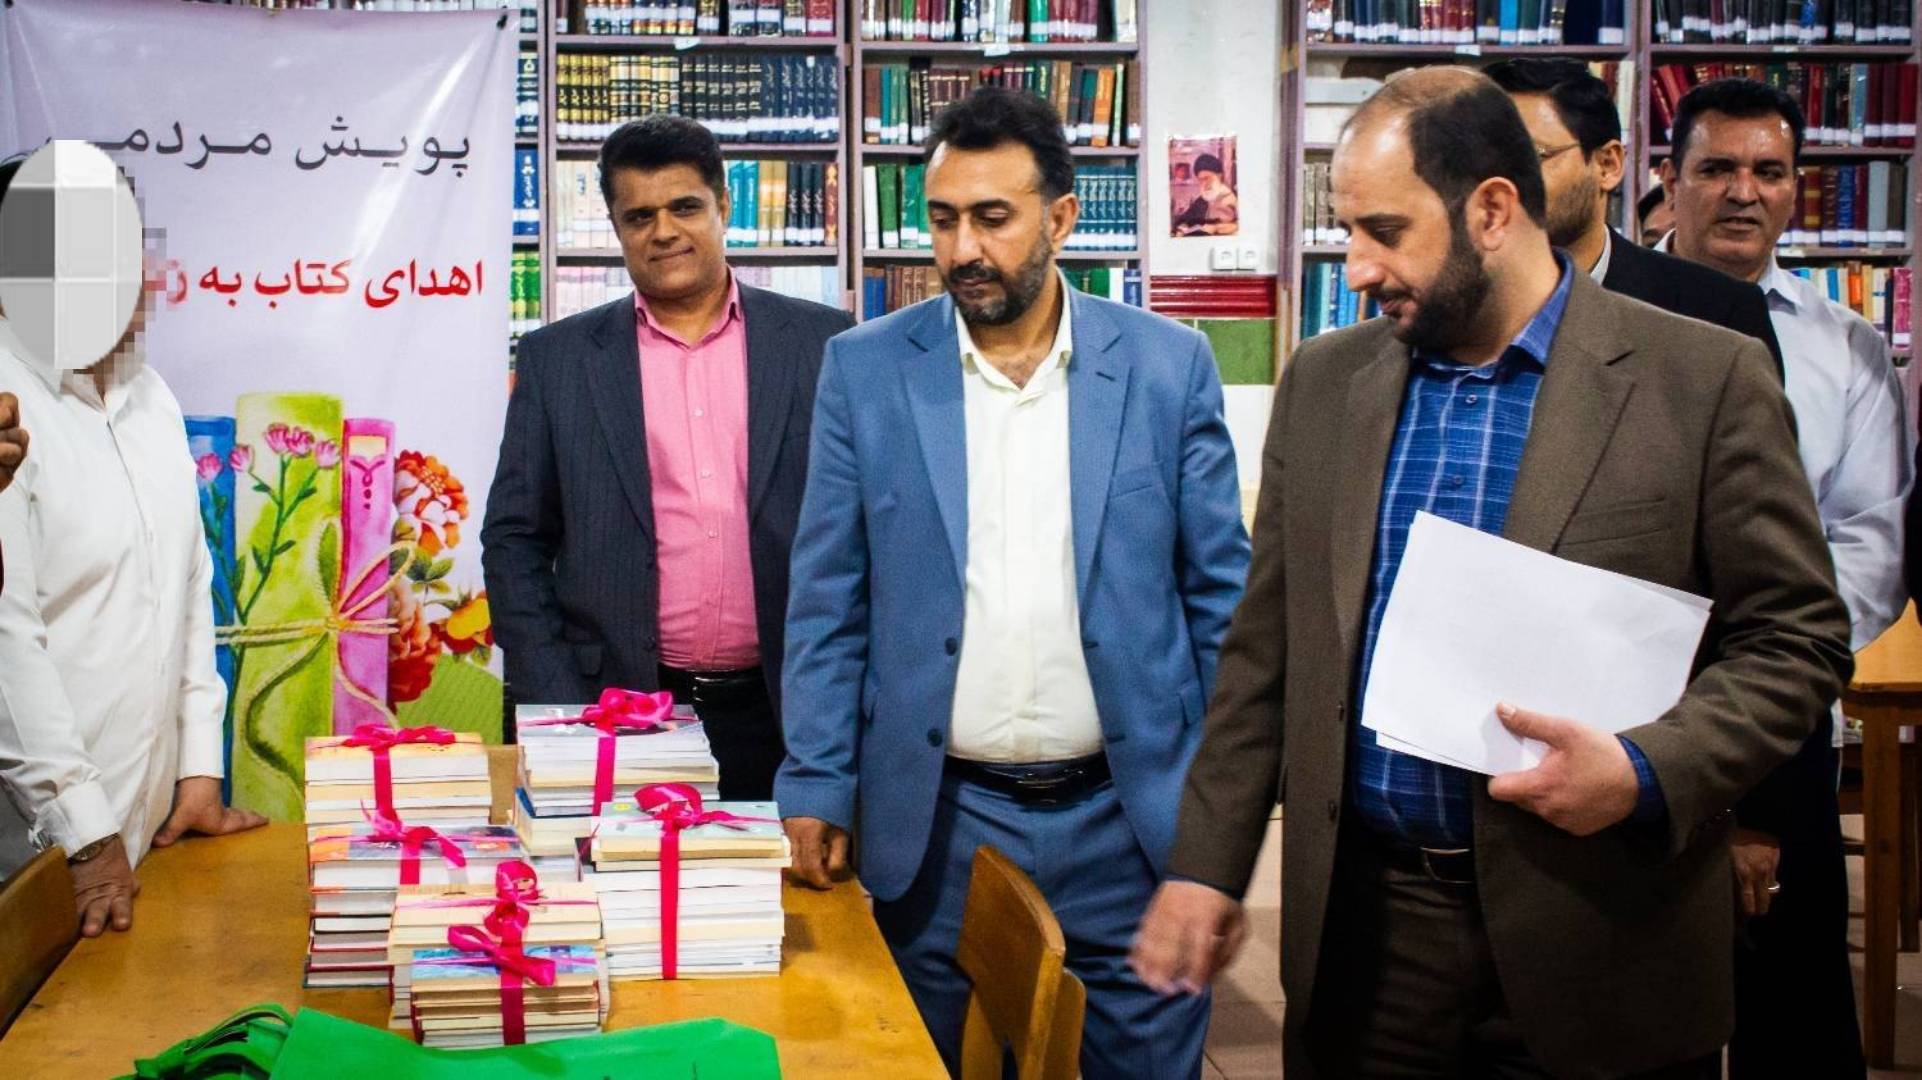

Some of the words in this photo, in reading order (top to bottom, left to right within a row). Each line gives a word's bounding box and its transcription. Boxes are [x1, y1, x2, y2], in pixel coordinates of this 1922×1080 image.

[46, 121, 272, 170] مردم
[294, 115, 470, 177] پویش
[199, 266, 244, 308] به
[253, 259, 351, 309] کتاب
[364, 259, 485, 309] اهدای
